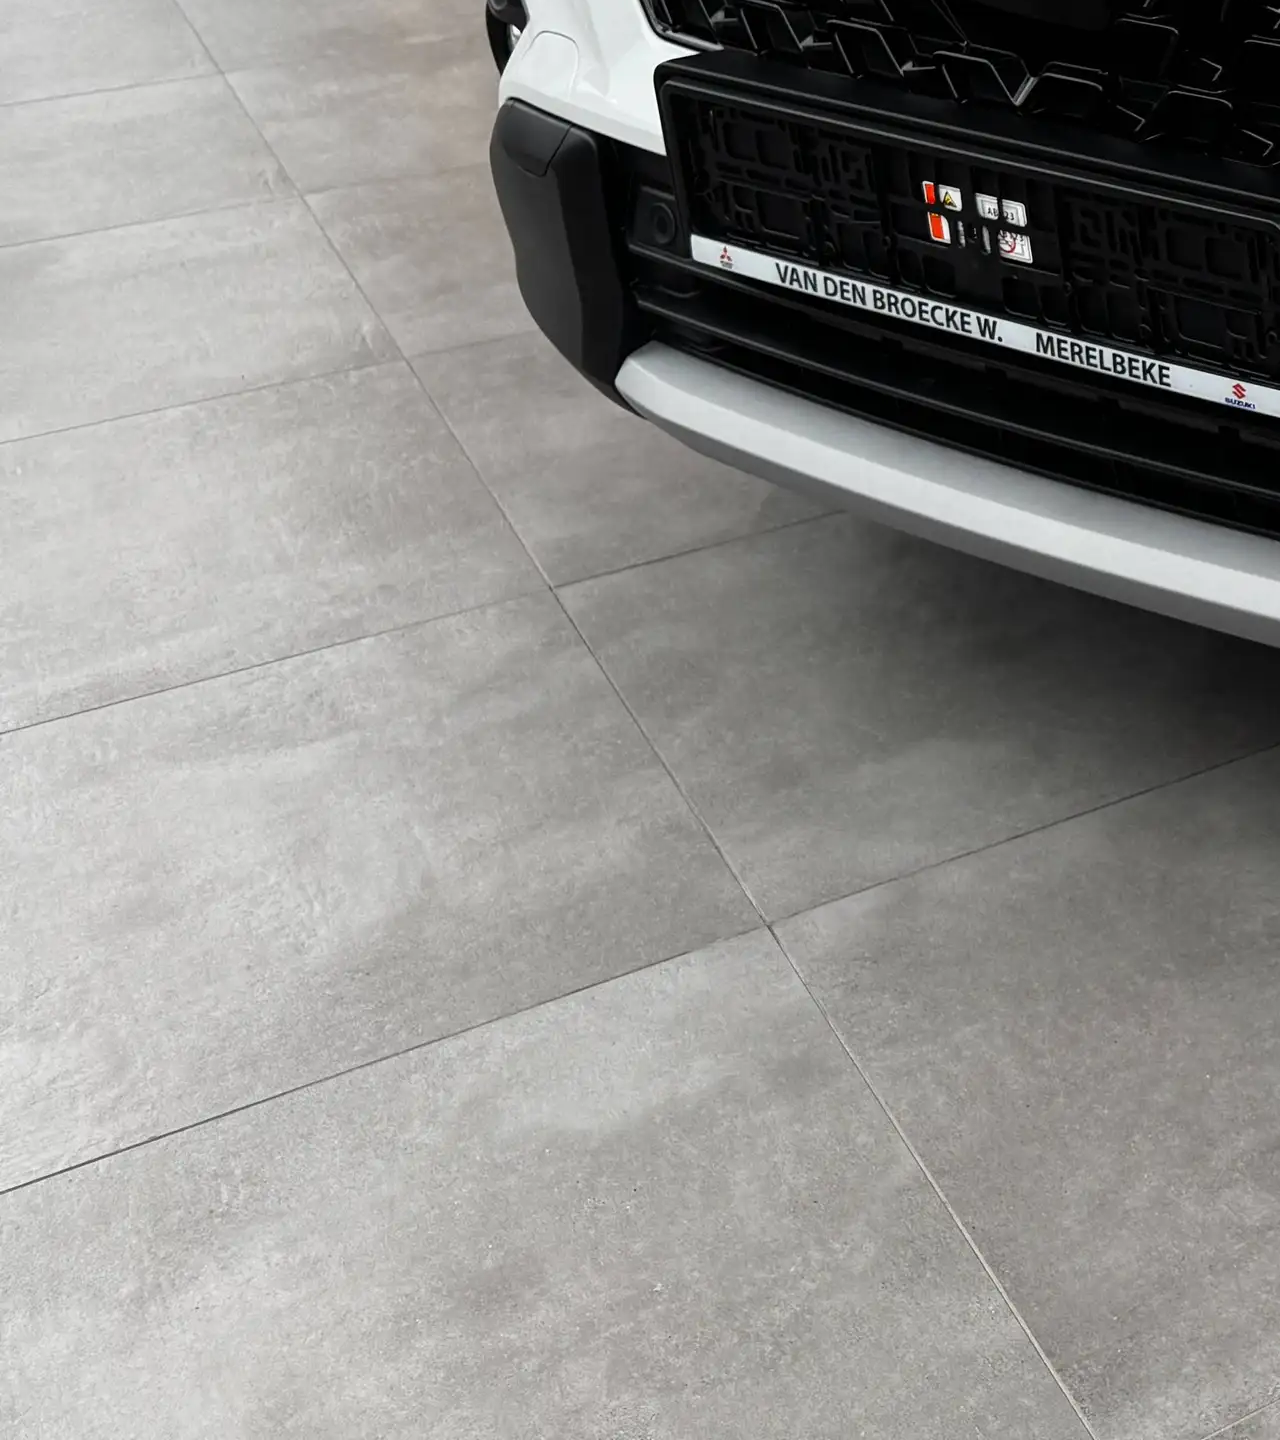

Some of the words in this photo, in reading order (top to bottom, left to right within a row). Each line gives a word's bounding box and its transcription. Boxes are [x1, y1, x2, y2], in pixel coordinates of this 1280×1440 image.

[774, 262, 818, 293] VAN
[822, 275, 867, 306] DEN
[872, 288, 973, 335] BROECKE
[975, 315, 1003, 342] W.
[1035, 332, 1172, 388] MERELBEKE
[1224, 396, 1256, 410] SUZUKI
